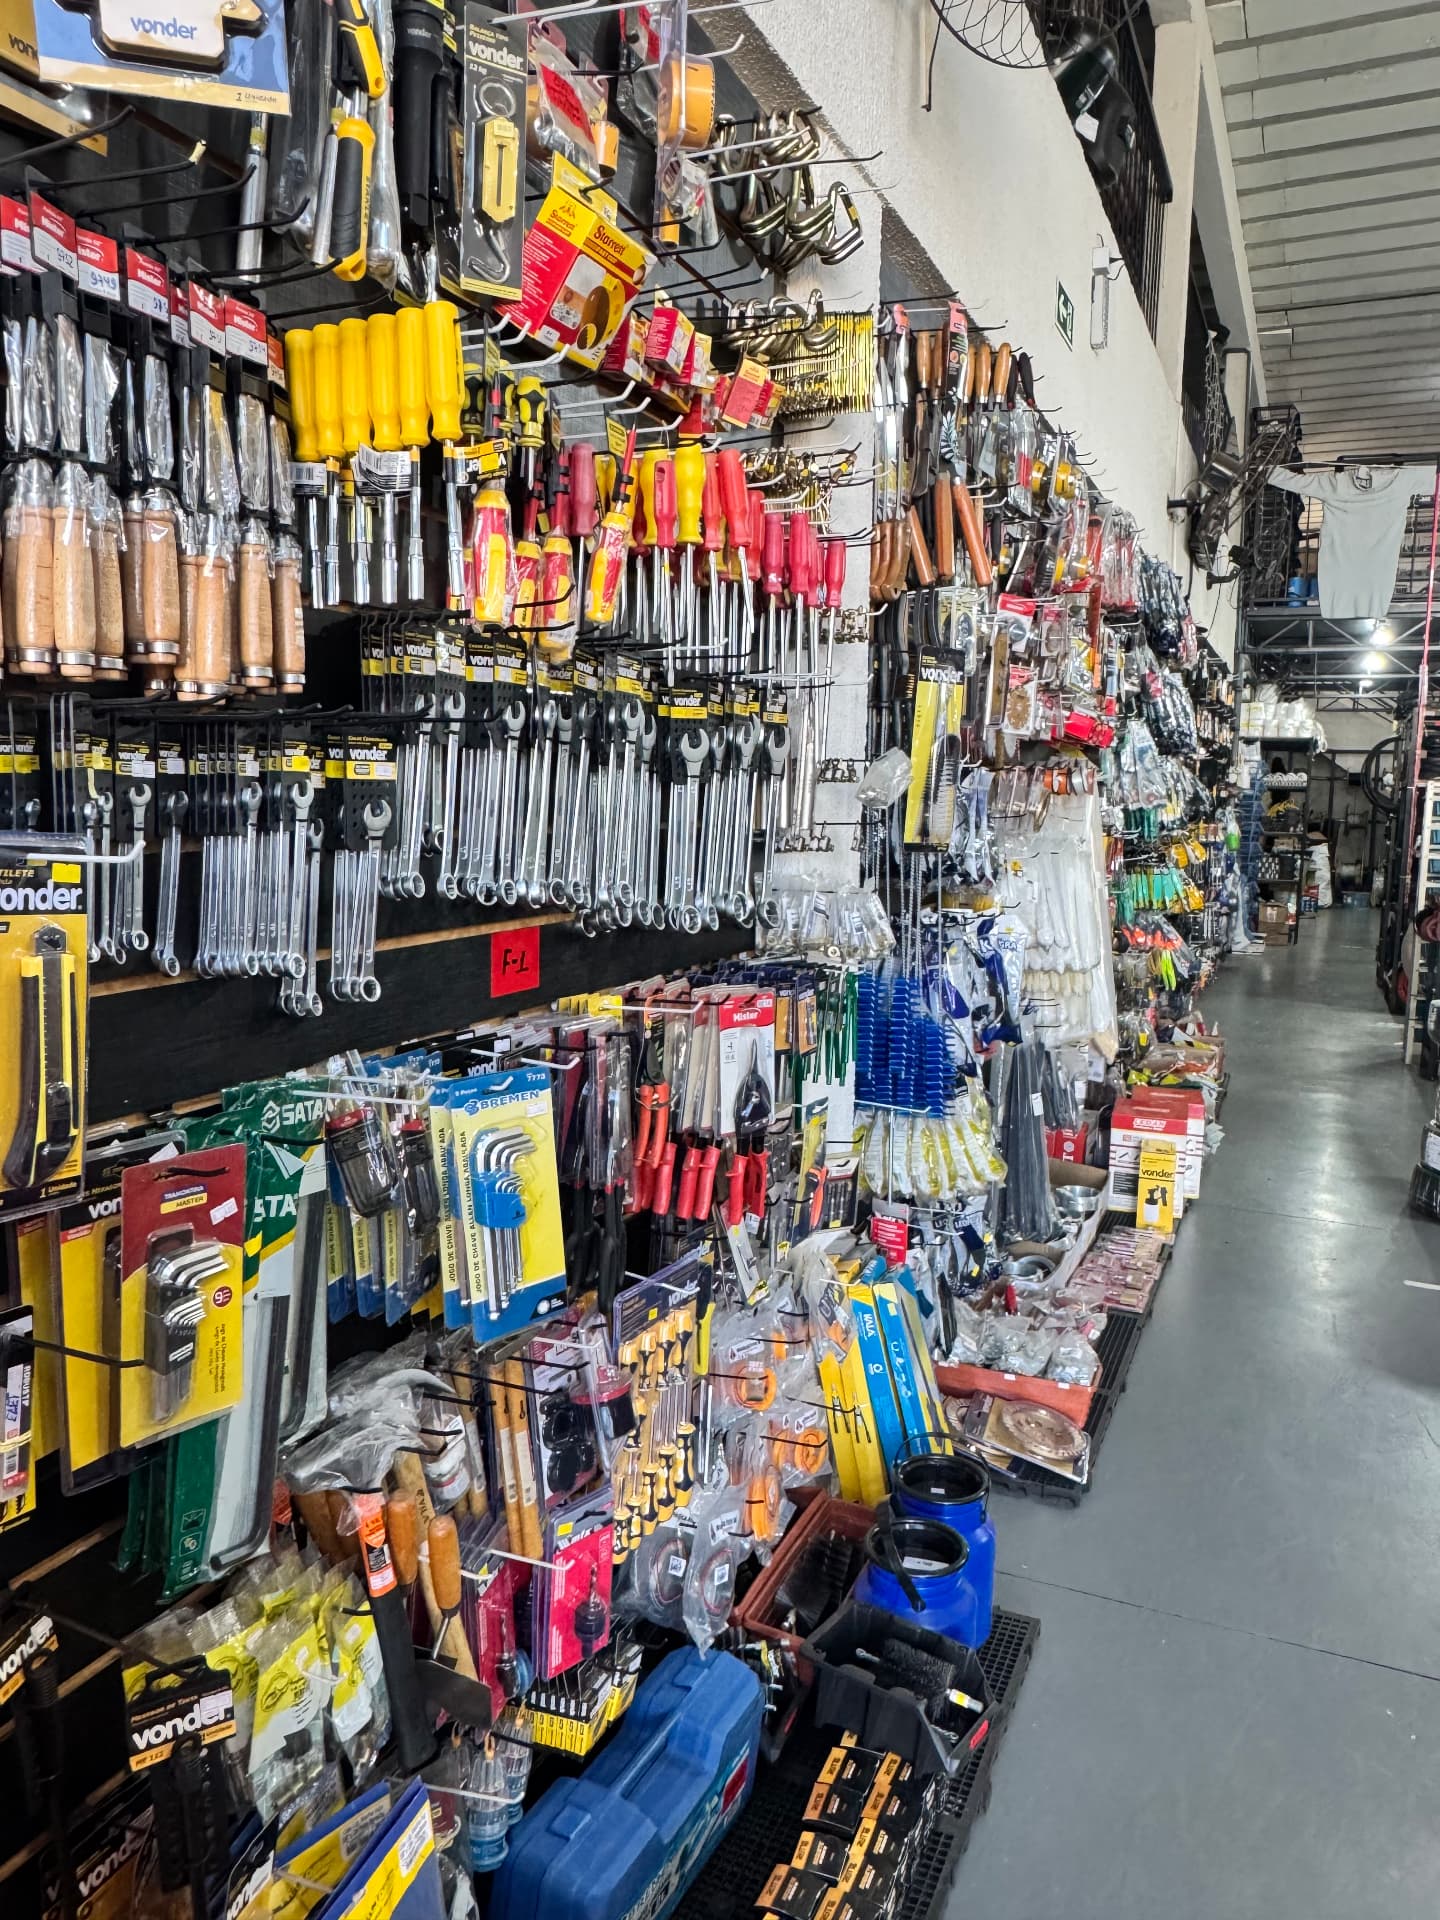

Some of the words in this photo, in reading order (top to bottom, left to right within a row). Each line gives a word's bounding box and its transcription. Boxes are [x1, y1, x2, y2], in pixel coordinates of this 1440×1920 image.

[130, 16, 198, 40] vonder
[9, 33, 38, 64] von
[469, 41, 524, 70] vonder
[77, 244, 104, 262] ister
[406, 644, 433, 658] vonder
[470, 654, 493, 667] von
[497, 654, 522, 669] vonder
[549, 667, 572, 680] onder
[674, 694, 701, 707] vonder
[349, 747, 387, 760] vonder
[0, 880, 82, 910] onder
[502, 948, 529, 976] F-1
[733, 1011, 759, 1023] Mister
[467, 1054, 497, 1077] vond
[480, 1090, 540, 1109] BREMEN
[1141, 1168, 1174, 1178] vonder
[89, 1198, 122, 1220] von
[176, 1196, 204, 1208] MASTER
[132, 1702, 226, 1750] vonder
[78, 1832, 131, 1897] vond
